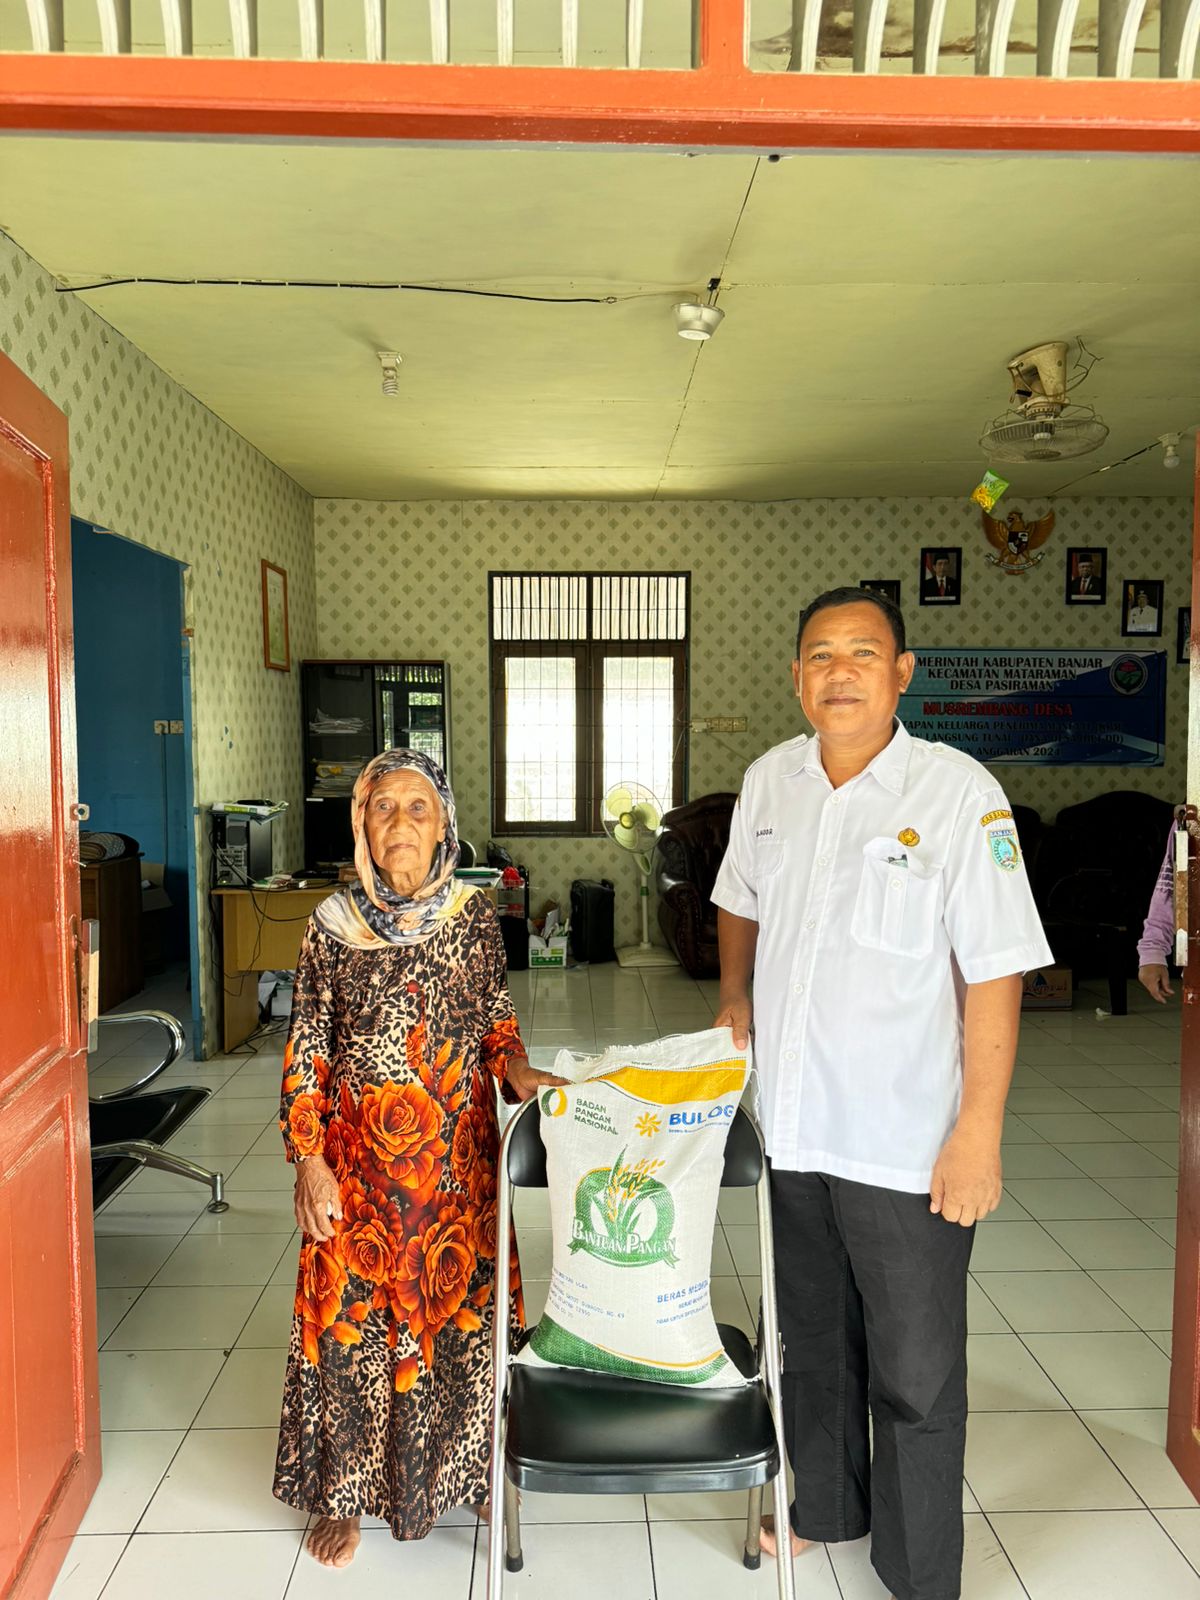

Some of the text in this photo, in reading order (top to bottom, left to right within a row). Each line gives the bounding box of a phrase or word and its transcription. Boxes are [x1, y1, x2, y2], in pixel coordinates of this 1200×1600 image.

[914, 656, 1104, 668] MERINTAH KABUPATEN BANJAR
[927, 667, 1077, 680] KECAMATAN MATARAMAN
[949, 679, 1054, 691] DESA PASIRAMAN
[1033, 702, 1073, 716] DESA
[903, 720, 934, 730] TAPAN
[937, 720, 990, 730] KELUARGA
[925, 732, 979, 743] LANGSUNG
[576, 1098, 607, 1114] BADAN
[575, 1106, 612, 1125] PANGAN
[669, 1104, 735, 1126] BULOG
[573, 1114, 619, 1135] NASIONAL
[657, 1288, 687, 1303] BERAS
